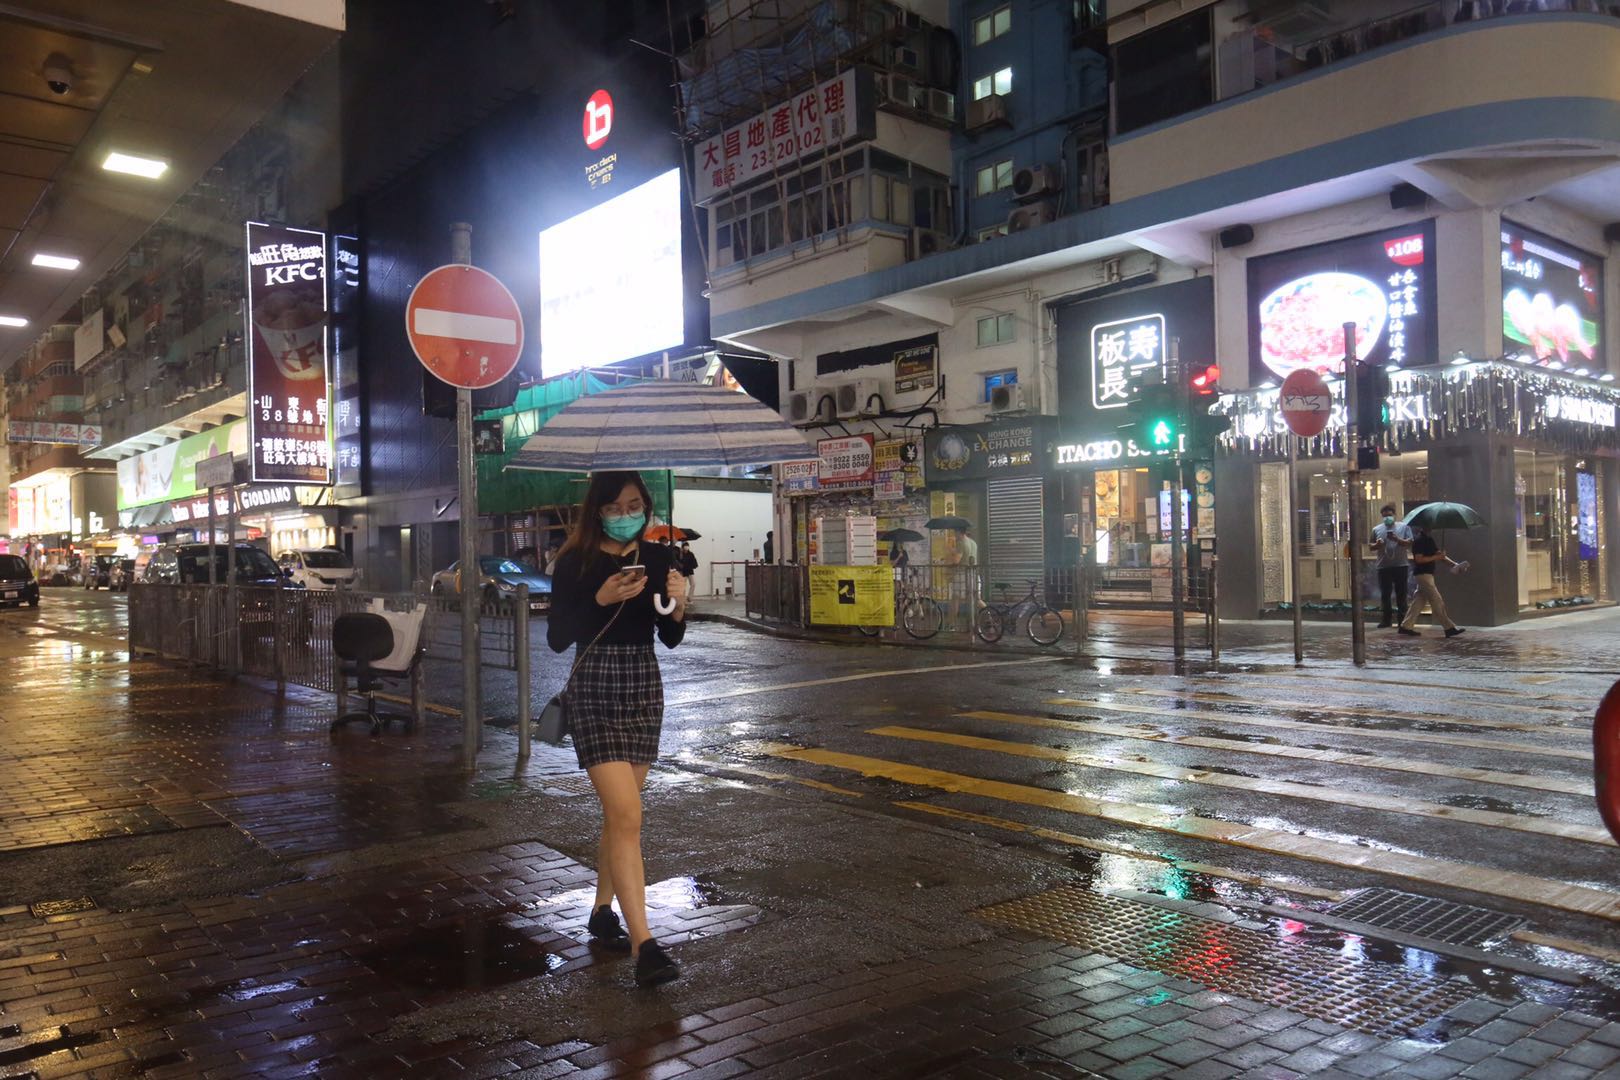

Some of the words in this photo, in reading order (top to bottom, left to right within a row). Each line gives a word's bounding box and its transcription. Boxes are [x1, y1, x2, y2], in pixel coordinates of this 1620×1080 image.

[703, 79, 846, 171] 大昌地產代理
[751, 126, 822, 172] 2320102
[1387, 238, 1423, 258] $108
[1098, 330, 1129, 402] 板長
[974, 433, 1032, 453] EXCHANGE
[988, 429, 1009, 439] HONG
[1010, 426, 1032, 437] KONG
[1057, 439, 1123, 464] ITACHO
[833, 462, 850, 470] 8300
[240, 486, 291, 509] GIORDANO
